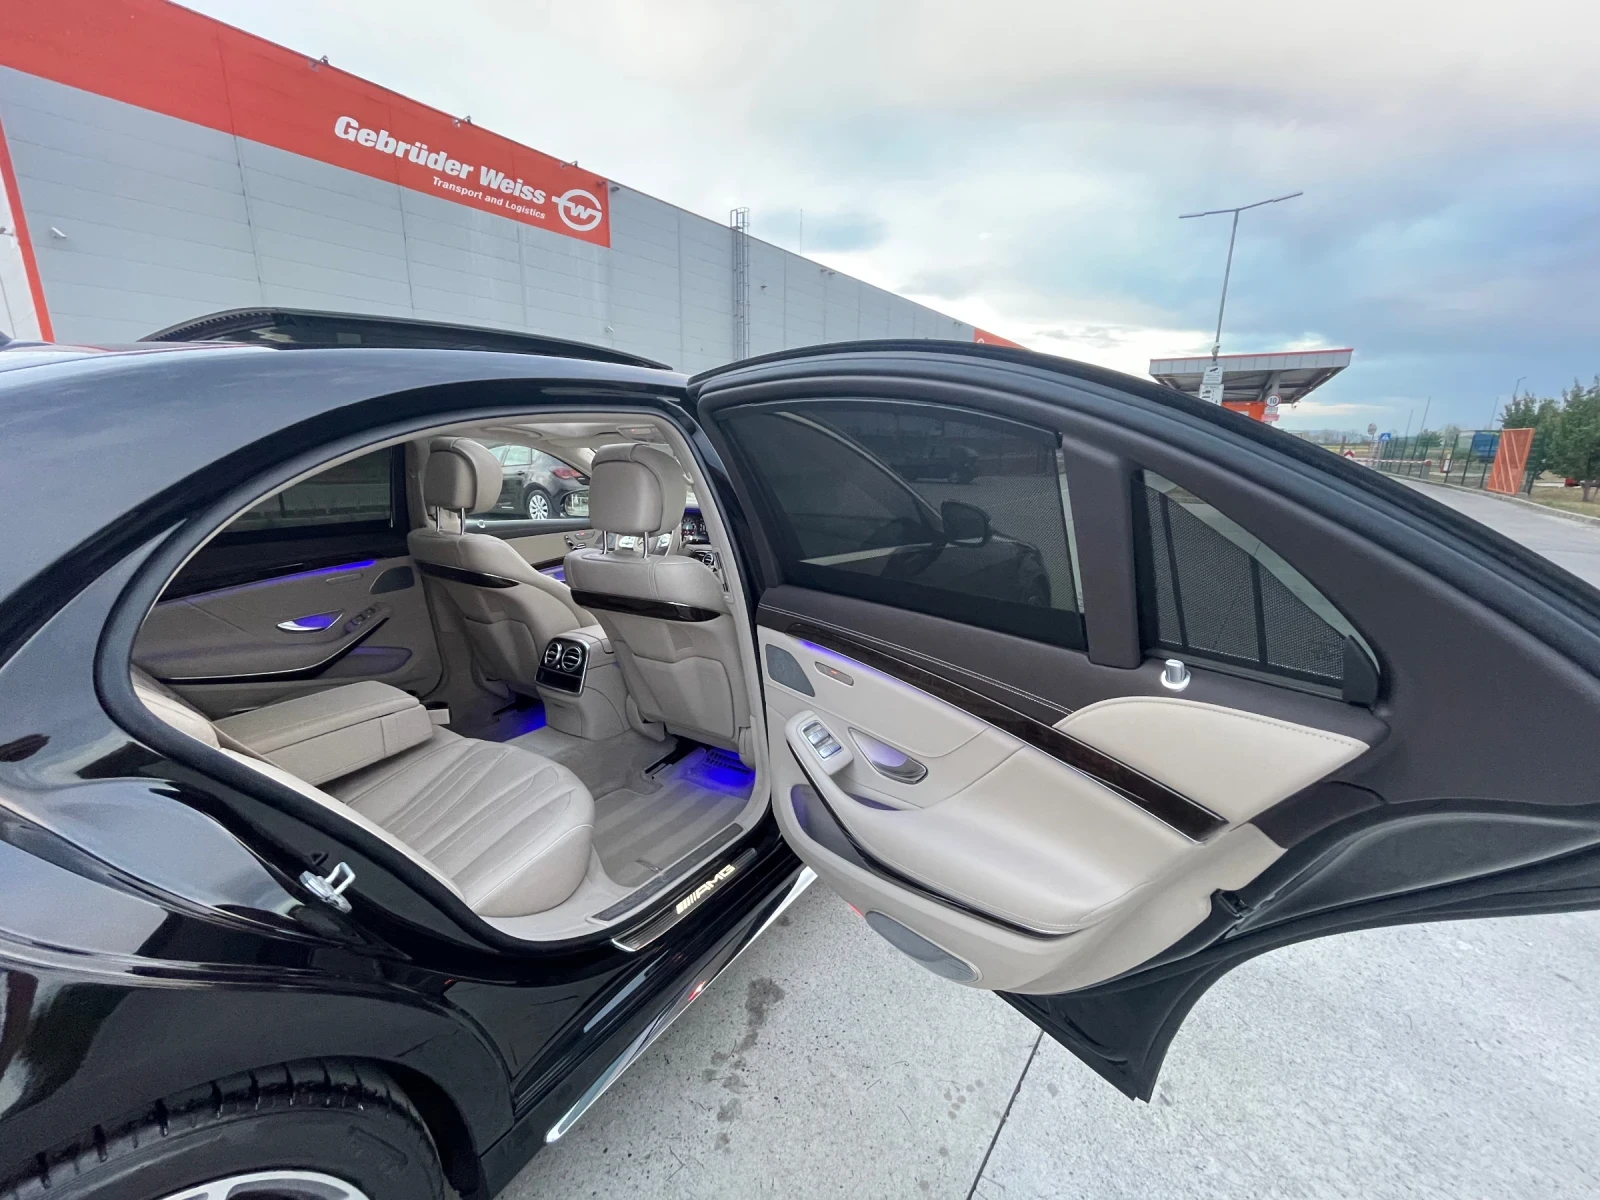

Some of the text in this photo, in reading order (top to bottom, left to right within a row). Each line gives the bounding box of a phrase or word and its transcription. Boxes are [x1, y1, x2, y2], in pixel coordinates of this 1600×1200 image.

[334, 115, 546, 204] Gebrüder Weiss
[433, 176, 546, 219] Transport and Logistics
